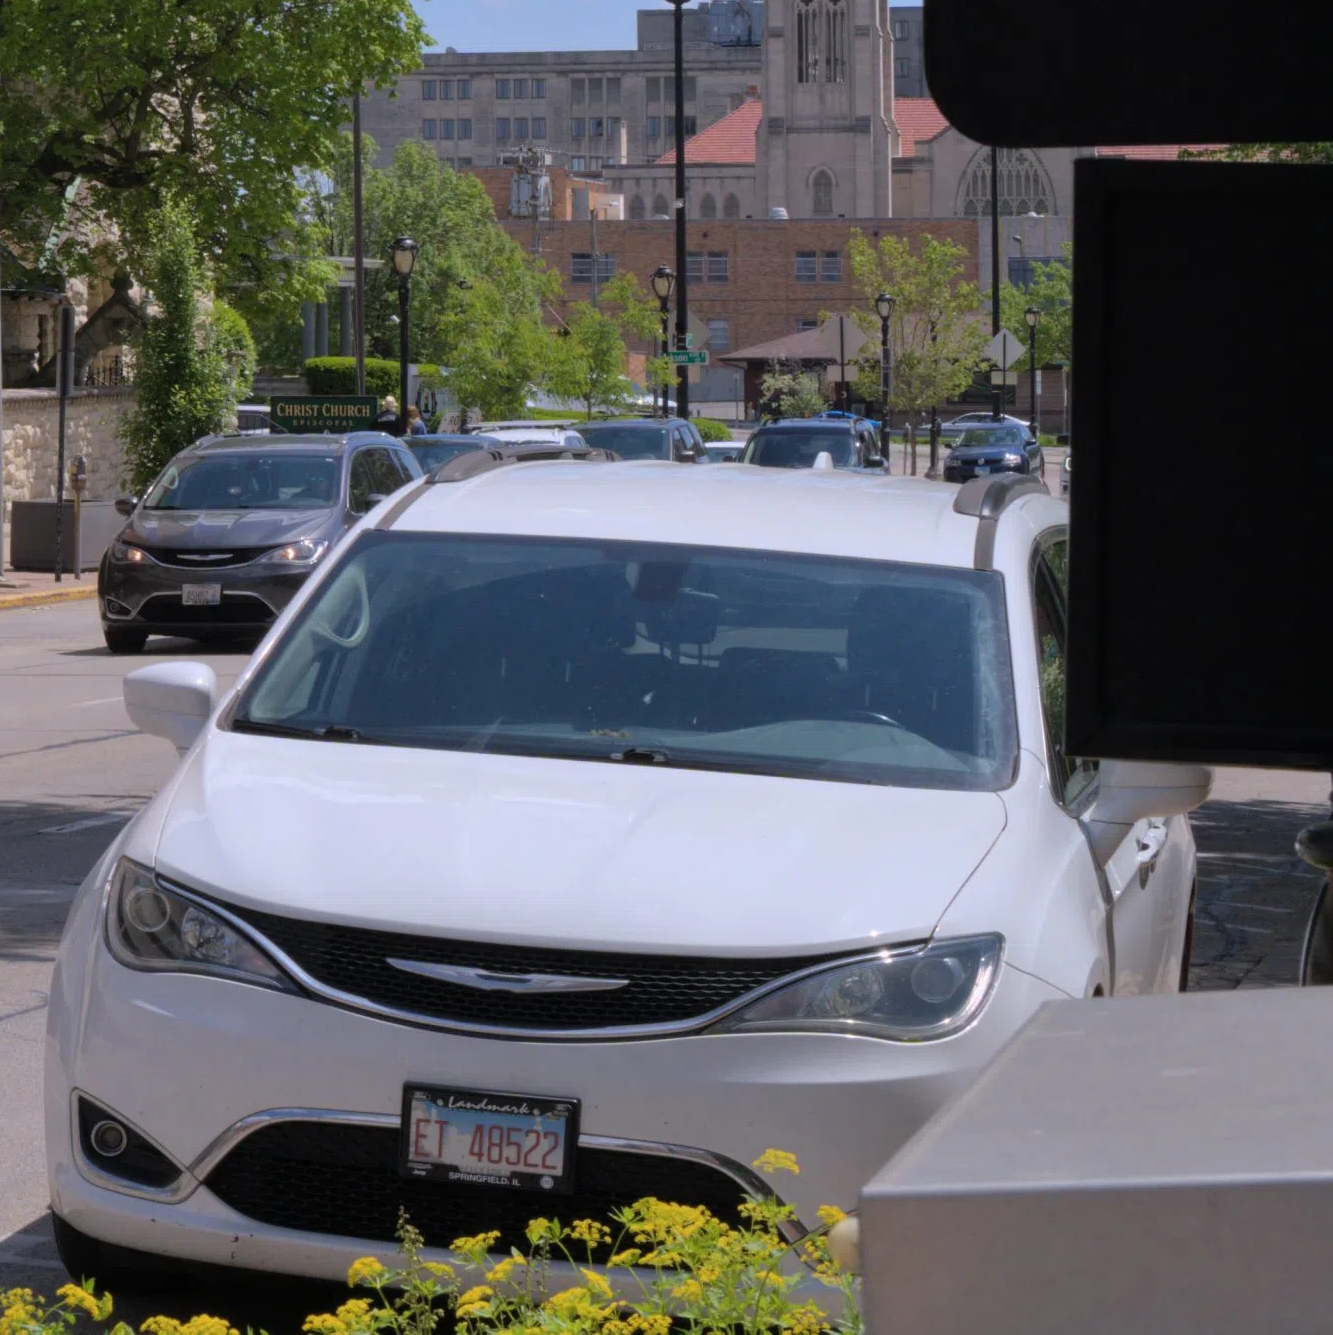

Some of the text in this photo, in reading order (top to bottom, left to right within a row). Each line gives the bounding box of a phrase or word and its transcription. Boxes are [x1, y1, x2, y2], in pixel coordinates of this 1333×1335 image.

[276, 402, 371, 417] CHRIST CHURCH
[448, 1095, 531, 1115] Landmark
[414, 1118, 560, 1170] ET 48522
[512, 1177, 522, 1187] IL
